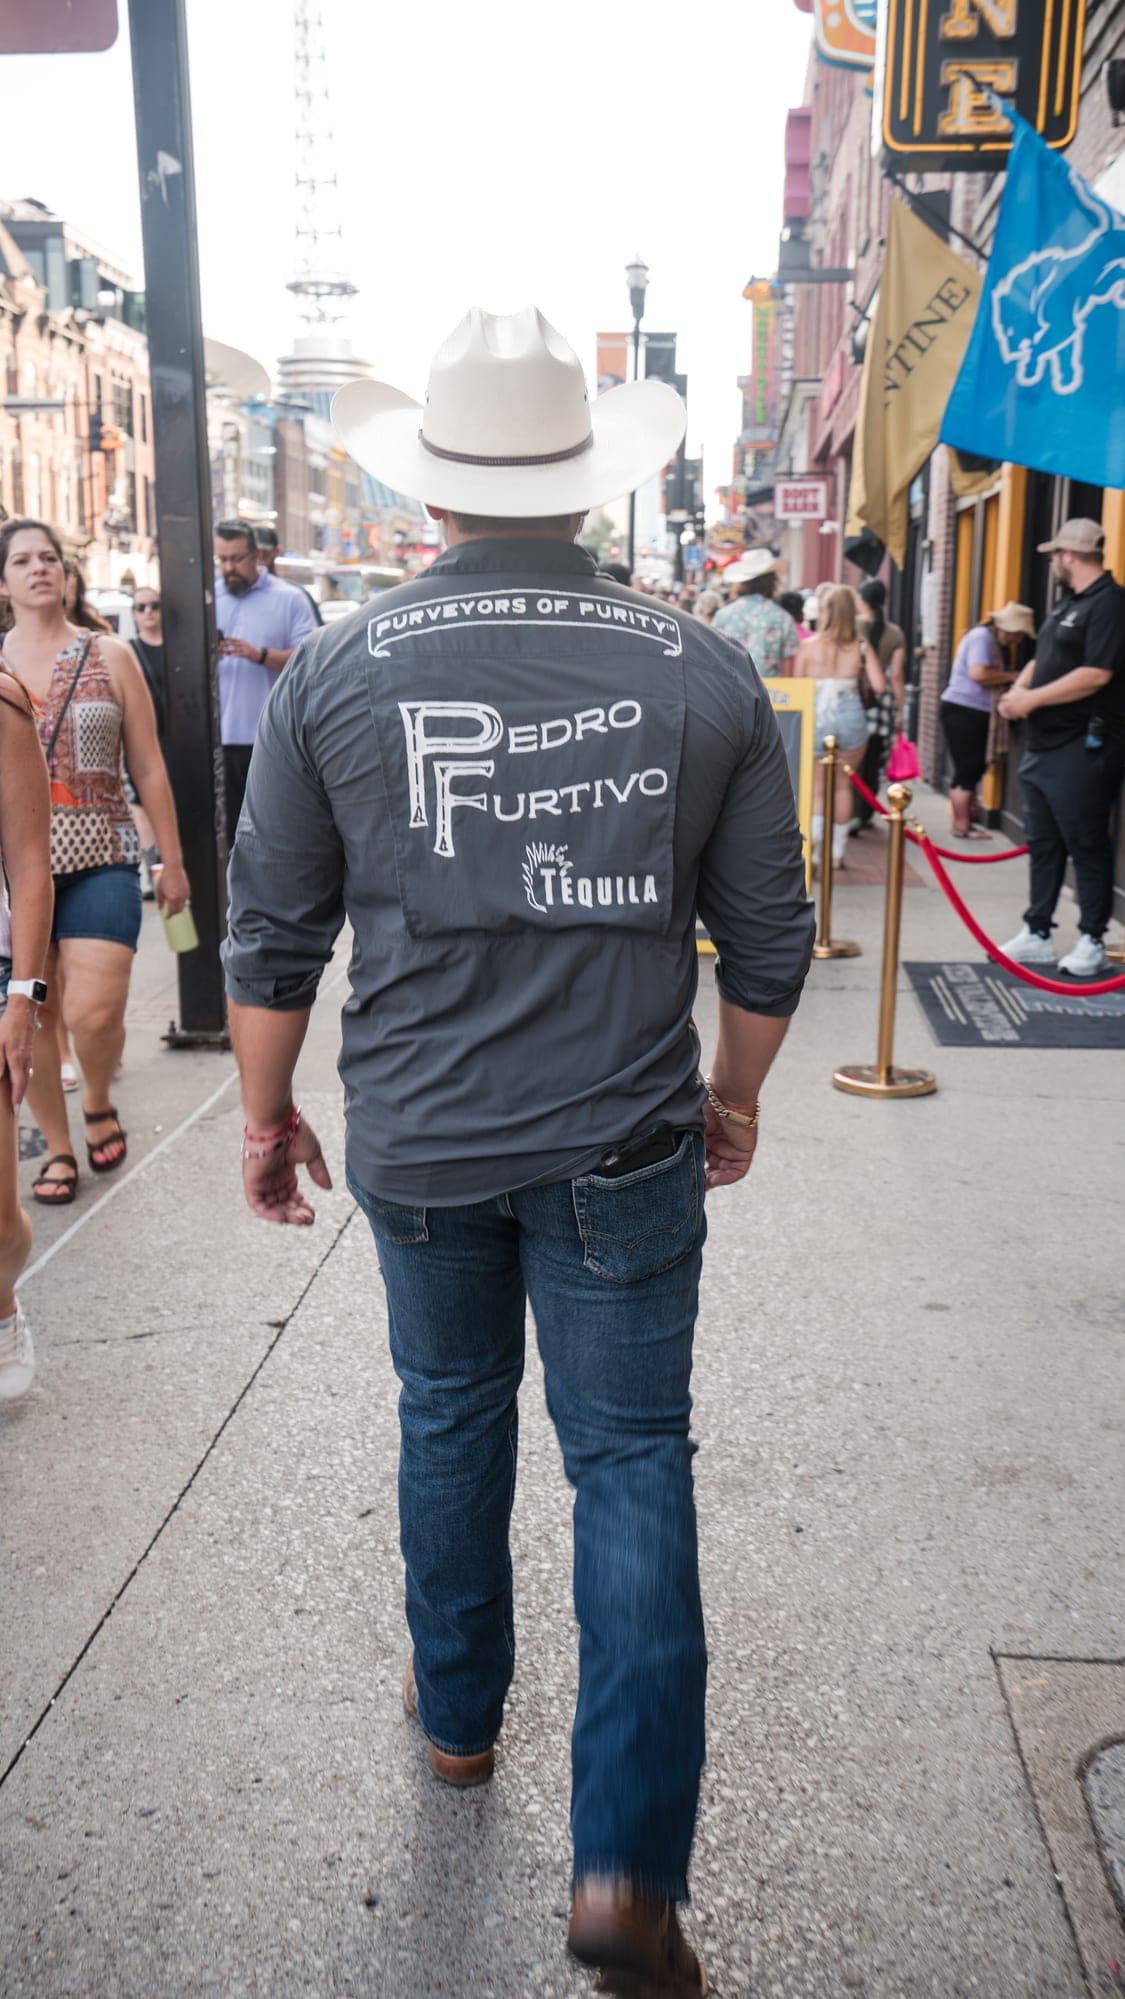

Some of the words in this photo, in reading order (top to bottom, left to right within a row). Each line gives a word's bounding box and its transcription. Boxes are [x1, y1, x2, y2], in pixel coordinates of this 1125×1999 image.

[376, 597, 527, 638] PURVEYORS
[536, 597, 569, 614] OF
[398, 699, 642, 828] PEDRO
[433, 760, 668, 857] FURTIVO
